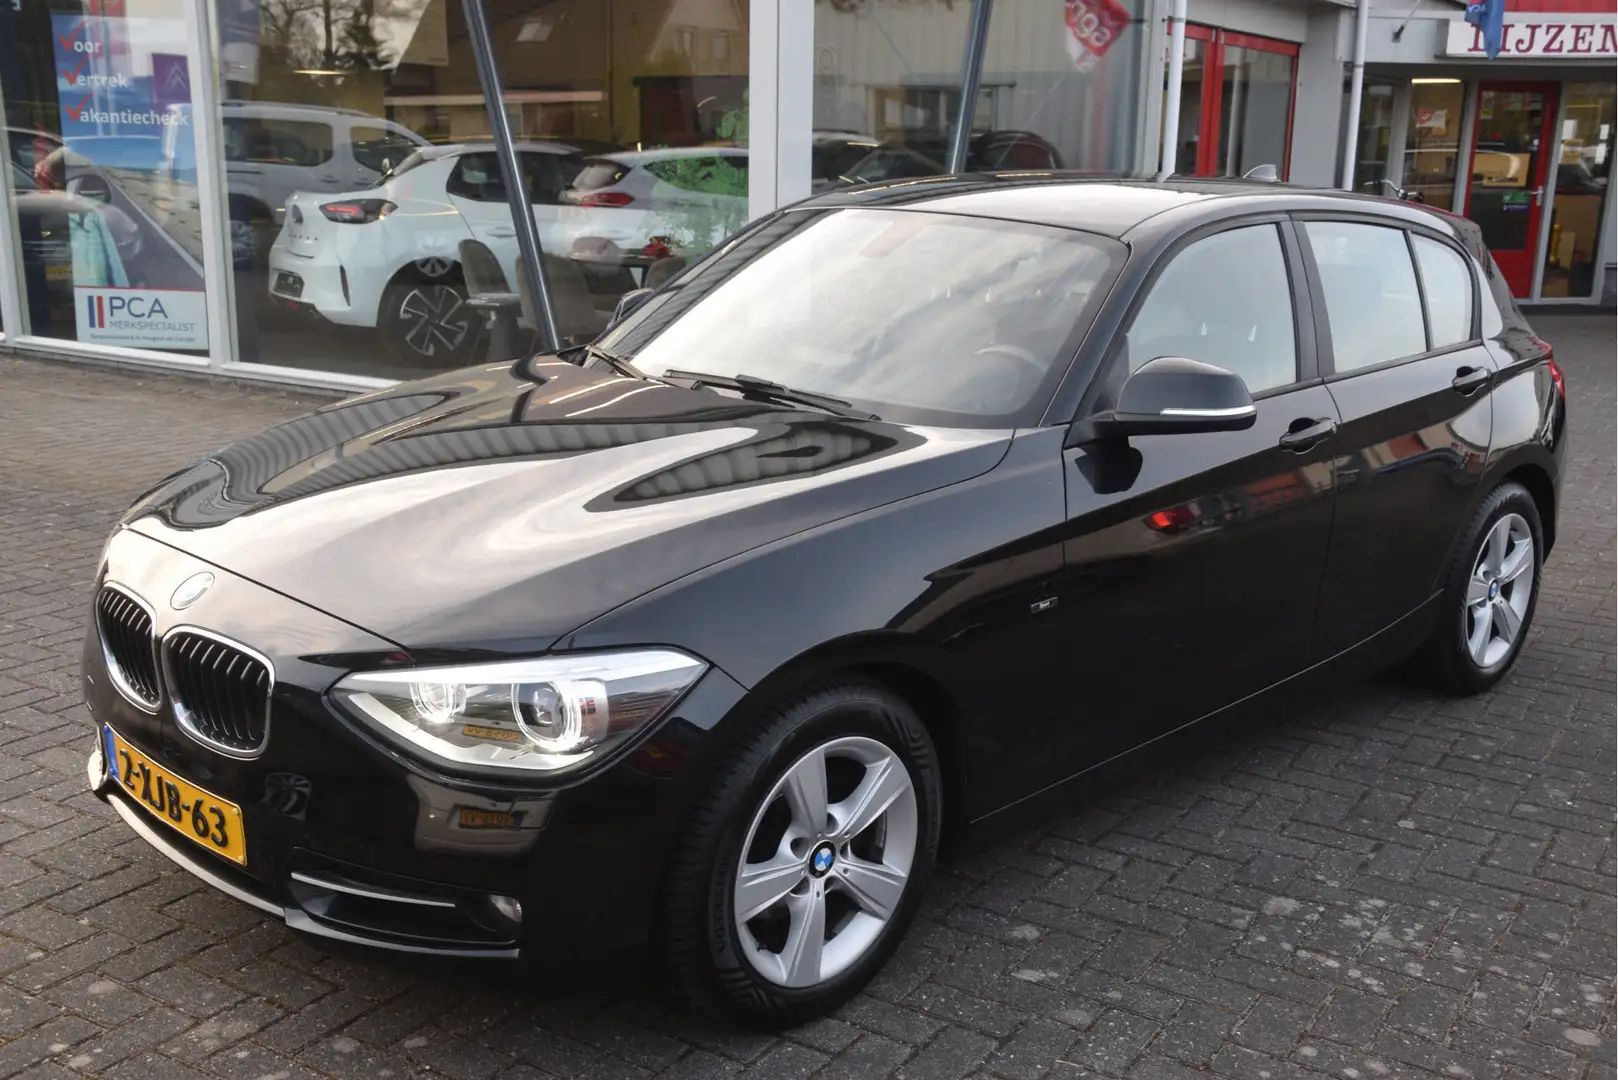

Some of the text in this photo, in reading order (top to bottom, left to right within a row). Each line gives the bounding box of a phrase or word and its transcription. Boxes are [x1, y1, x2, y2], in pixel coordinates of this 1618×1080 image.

[109, 296, 168, 319] PCA
[109, 320, 197, 332] MERKSPECIALIST
[119, 748, 228, 847] 2-XJB-63
